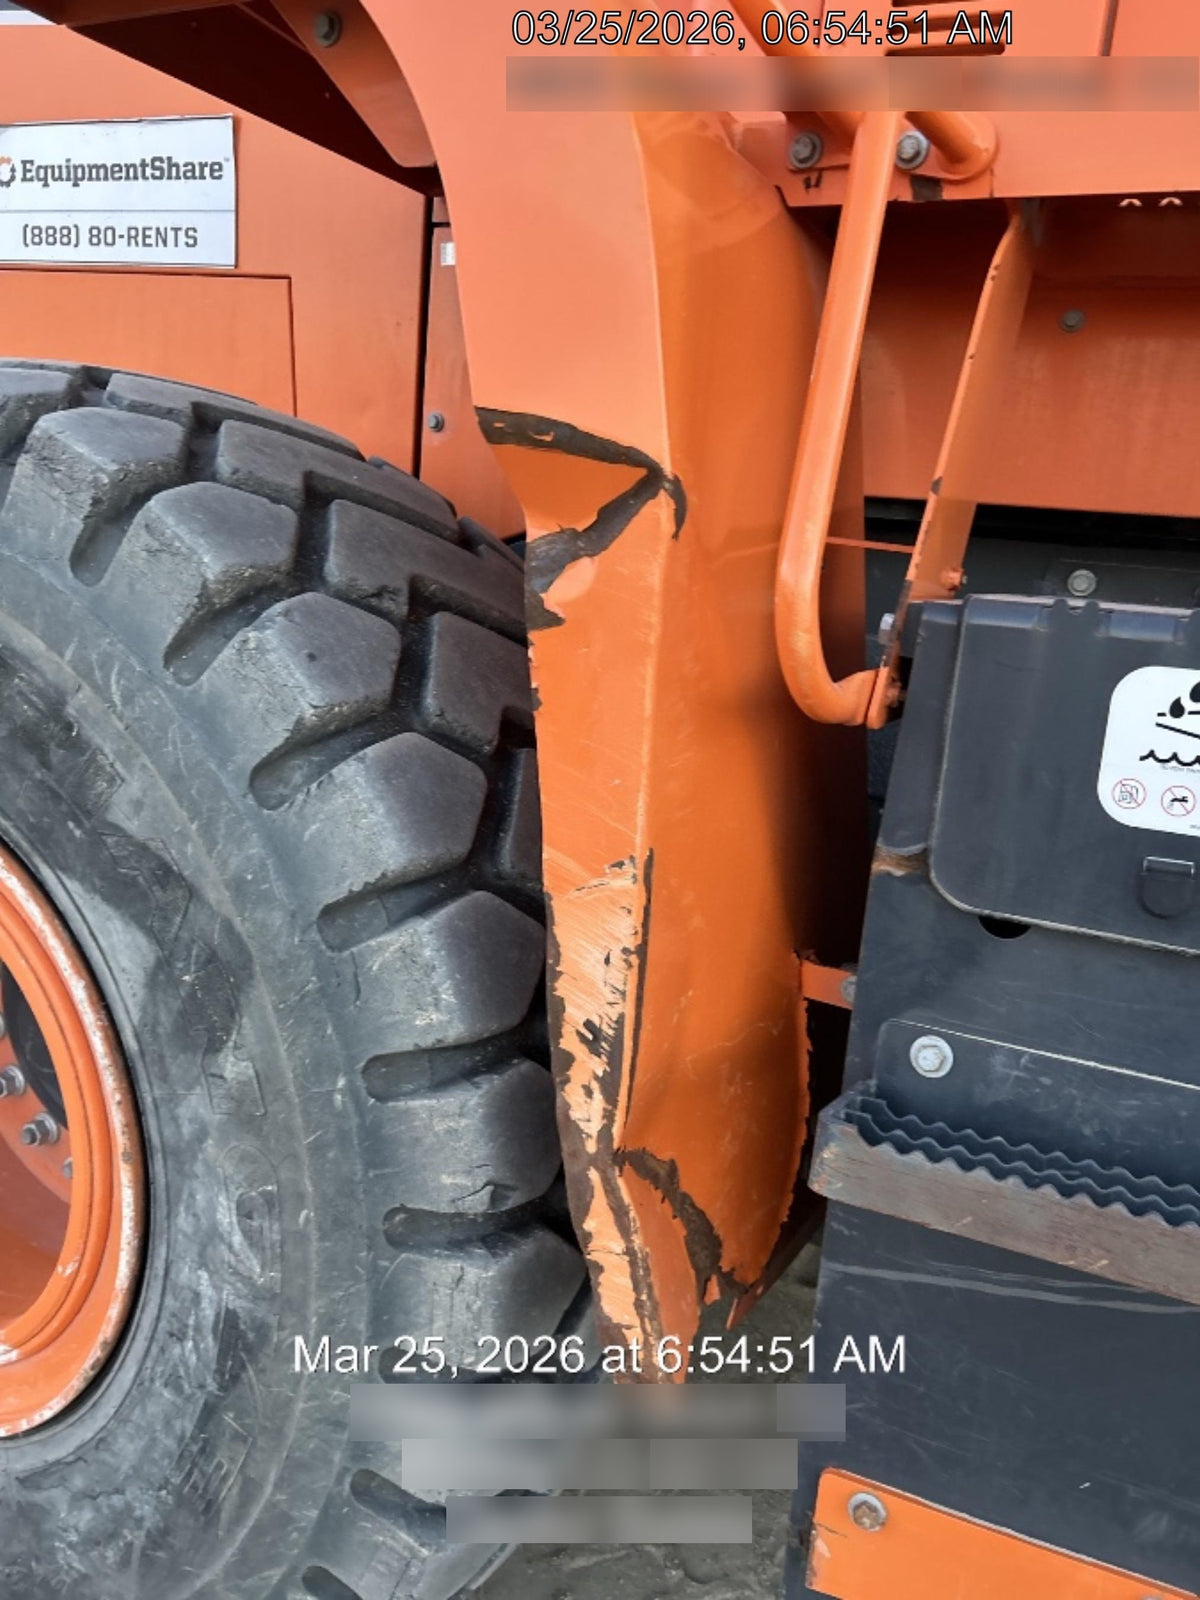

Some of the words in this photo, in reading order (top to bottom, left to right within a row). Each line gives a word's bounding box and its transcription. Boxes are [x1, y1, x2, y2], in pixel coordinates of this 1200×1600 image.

[21, 156, 223, 187] EquipmentShare
[22, 224, 80, 248] (888)
[88, 225, 198, 248] 80-RENTS
